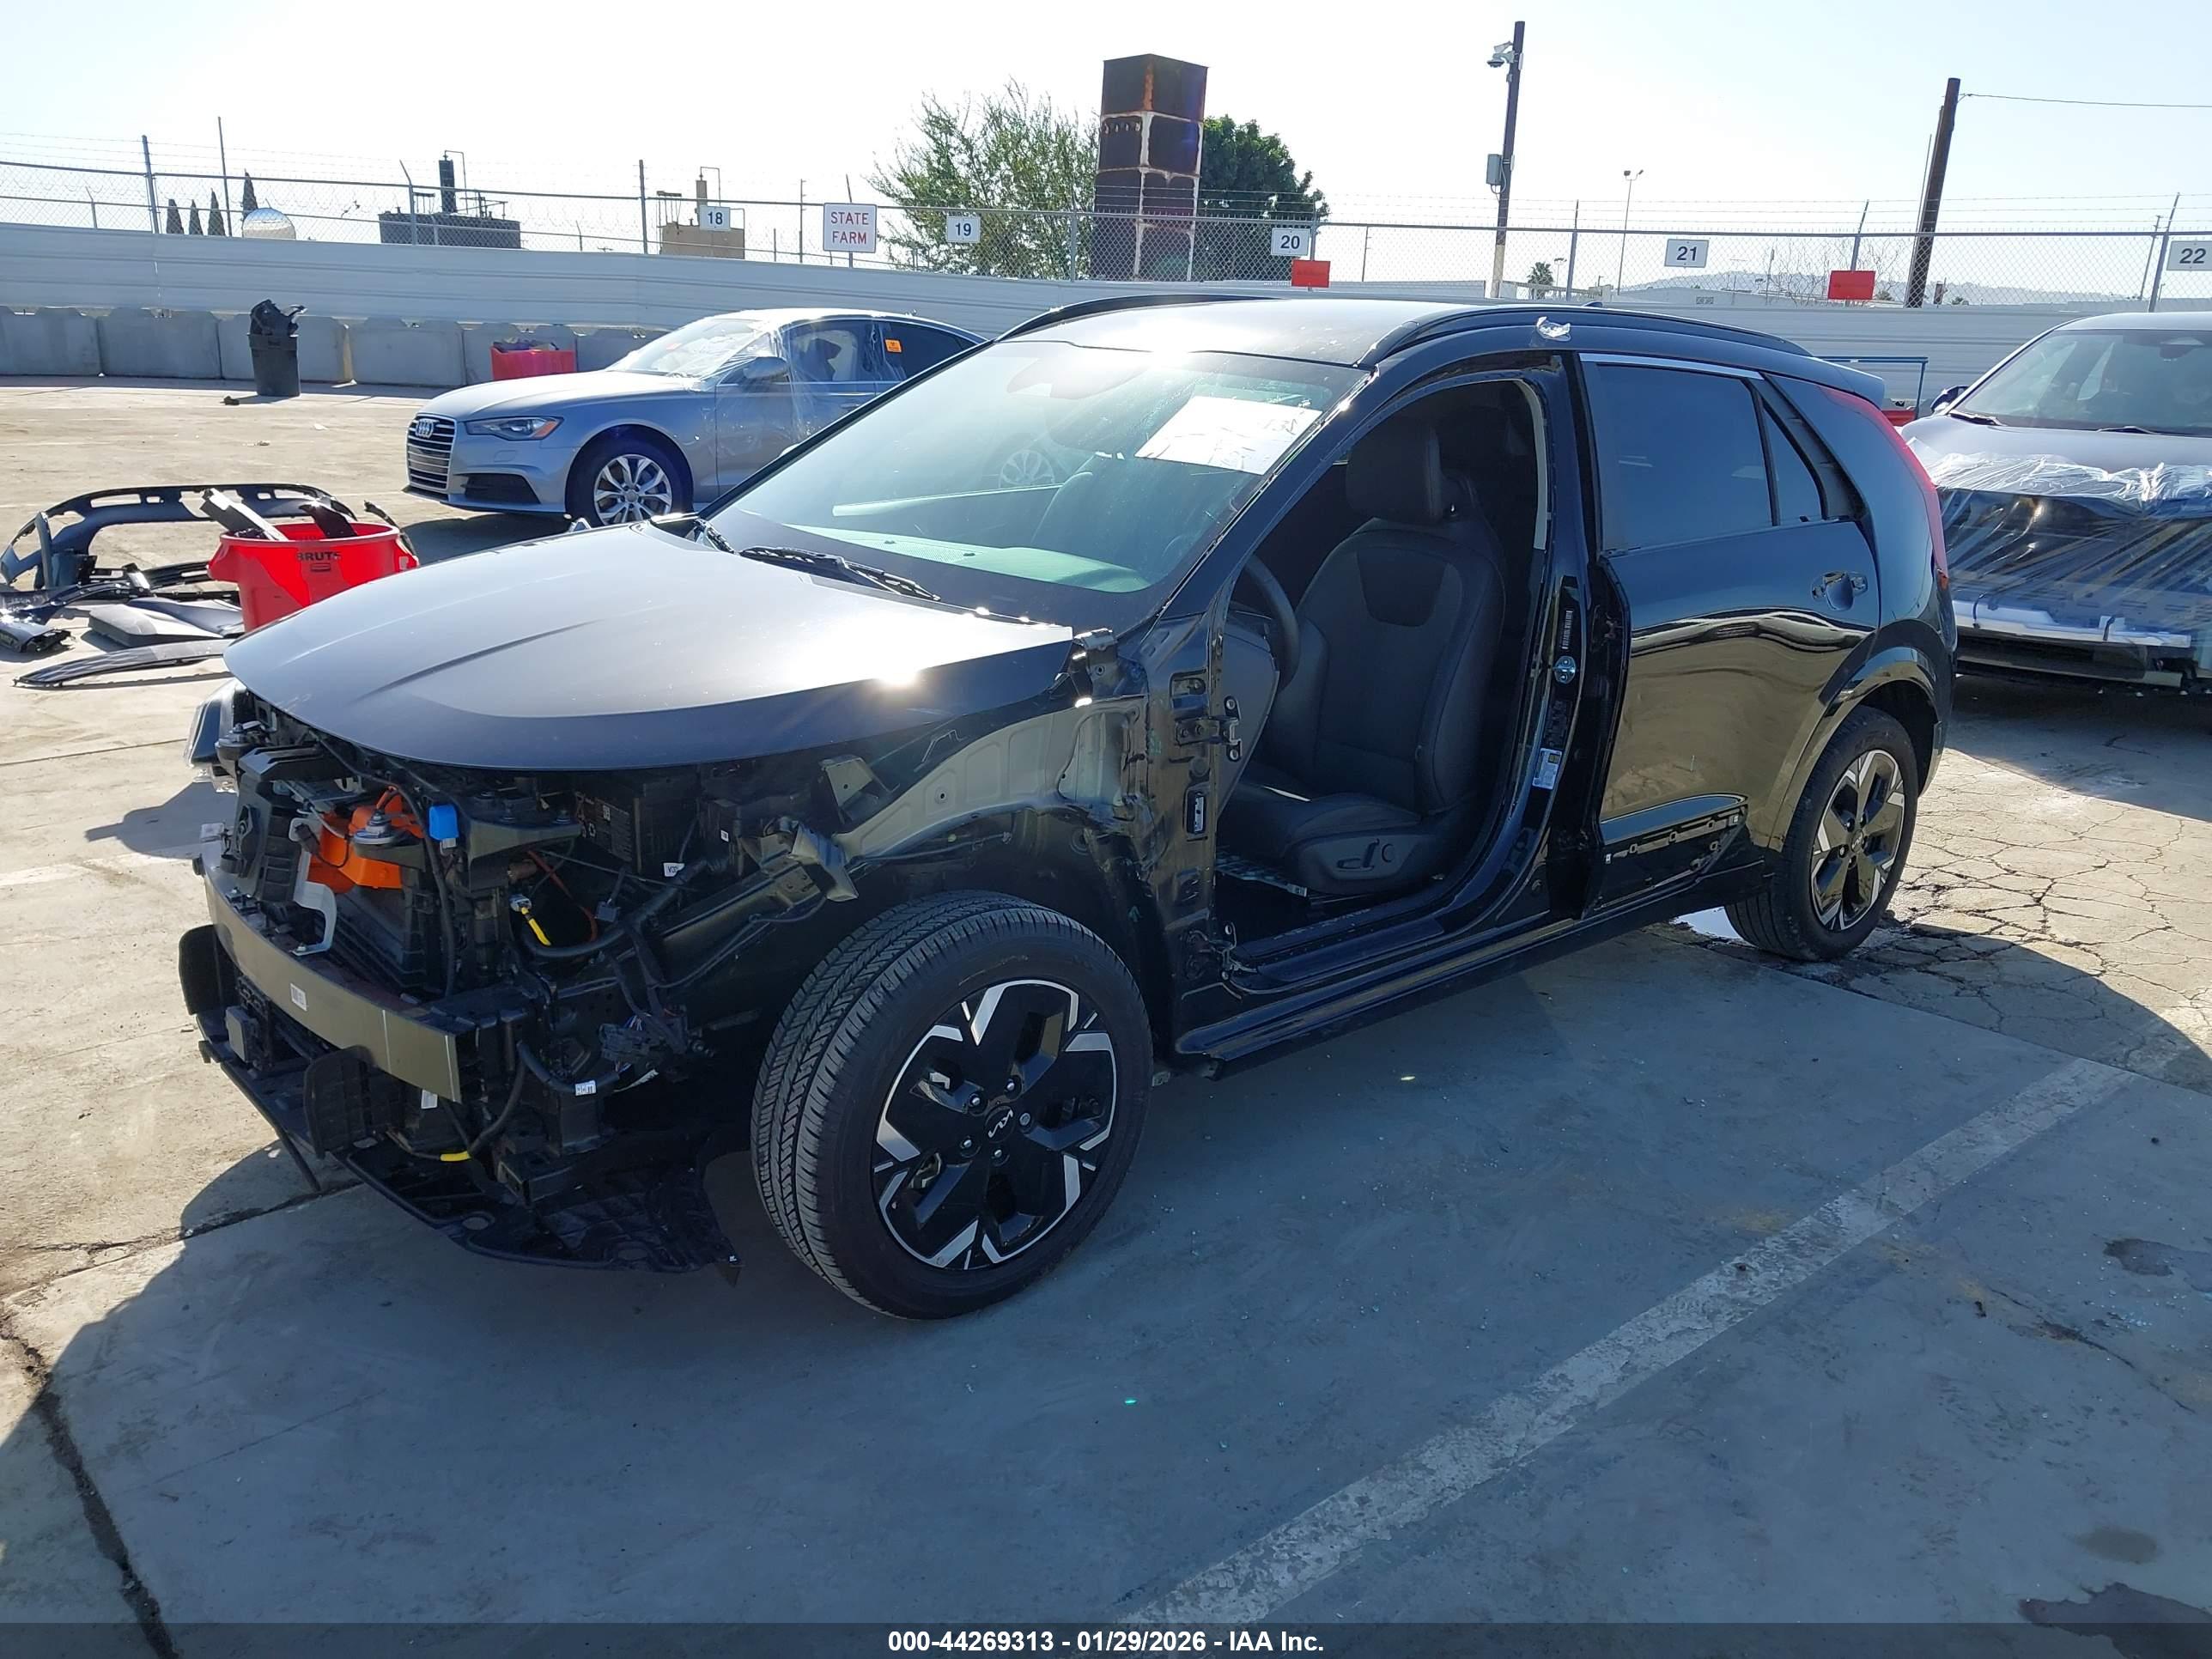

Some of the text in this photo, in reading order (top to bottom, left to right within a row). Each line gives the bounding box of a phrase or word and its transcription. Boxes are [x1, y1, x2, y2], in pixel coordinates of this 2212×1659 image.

[708, 211, 723, 225] 18
[830, 211, 869, 225] STATE
[955, 222, 971, 236] 19
[832, 230, 866, 244] FARM
[1280, 234, 1300, 249] 20
[1676, 246, 1697, 261] 21
[2179, 247, 2207, 264] 22
